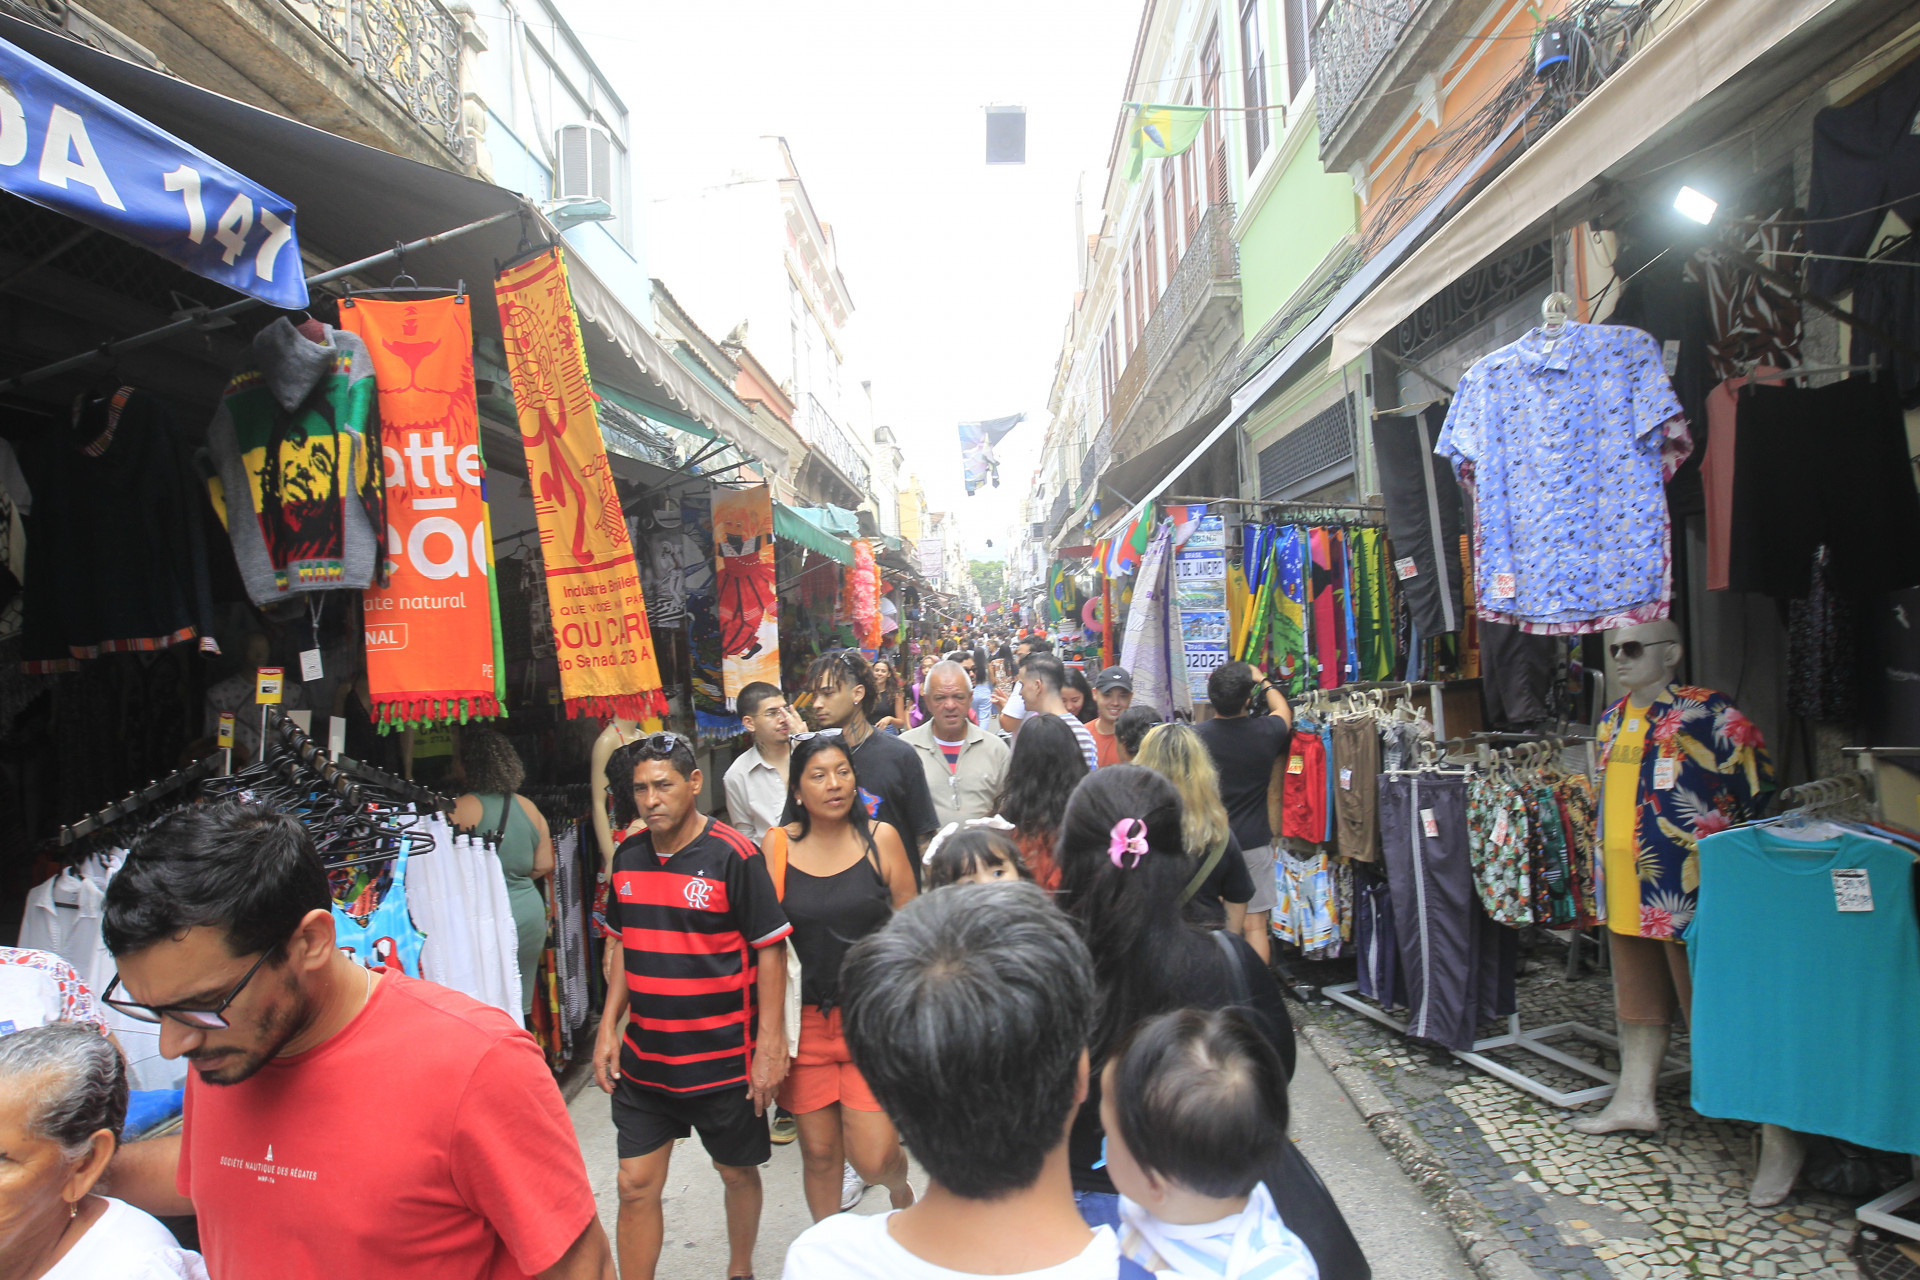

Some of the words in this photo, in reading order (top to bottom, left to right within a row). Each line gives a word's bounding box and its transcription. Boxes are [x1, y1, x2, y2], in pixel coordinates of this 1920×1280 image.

[163, 164, 291, 282] 147
[400, 592, 466, 610] natural
[560, 605, 586, 616] QUE
[245, 1161, 276, 1175] NAUTIQUE
[277, 1165, 289, 1177] DES
[290, 1166, 318, 1181] RÉGATES
